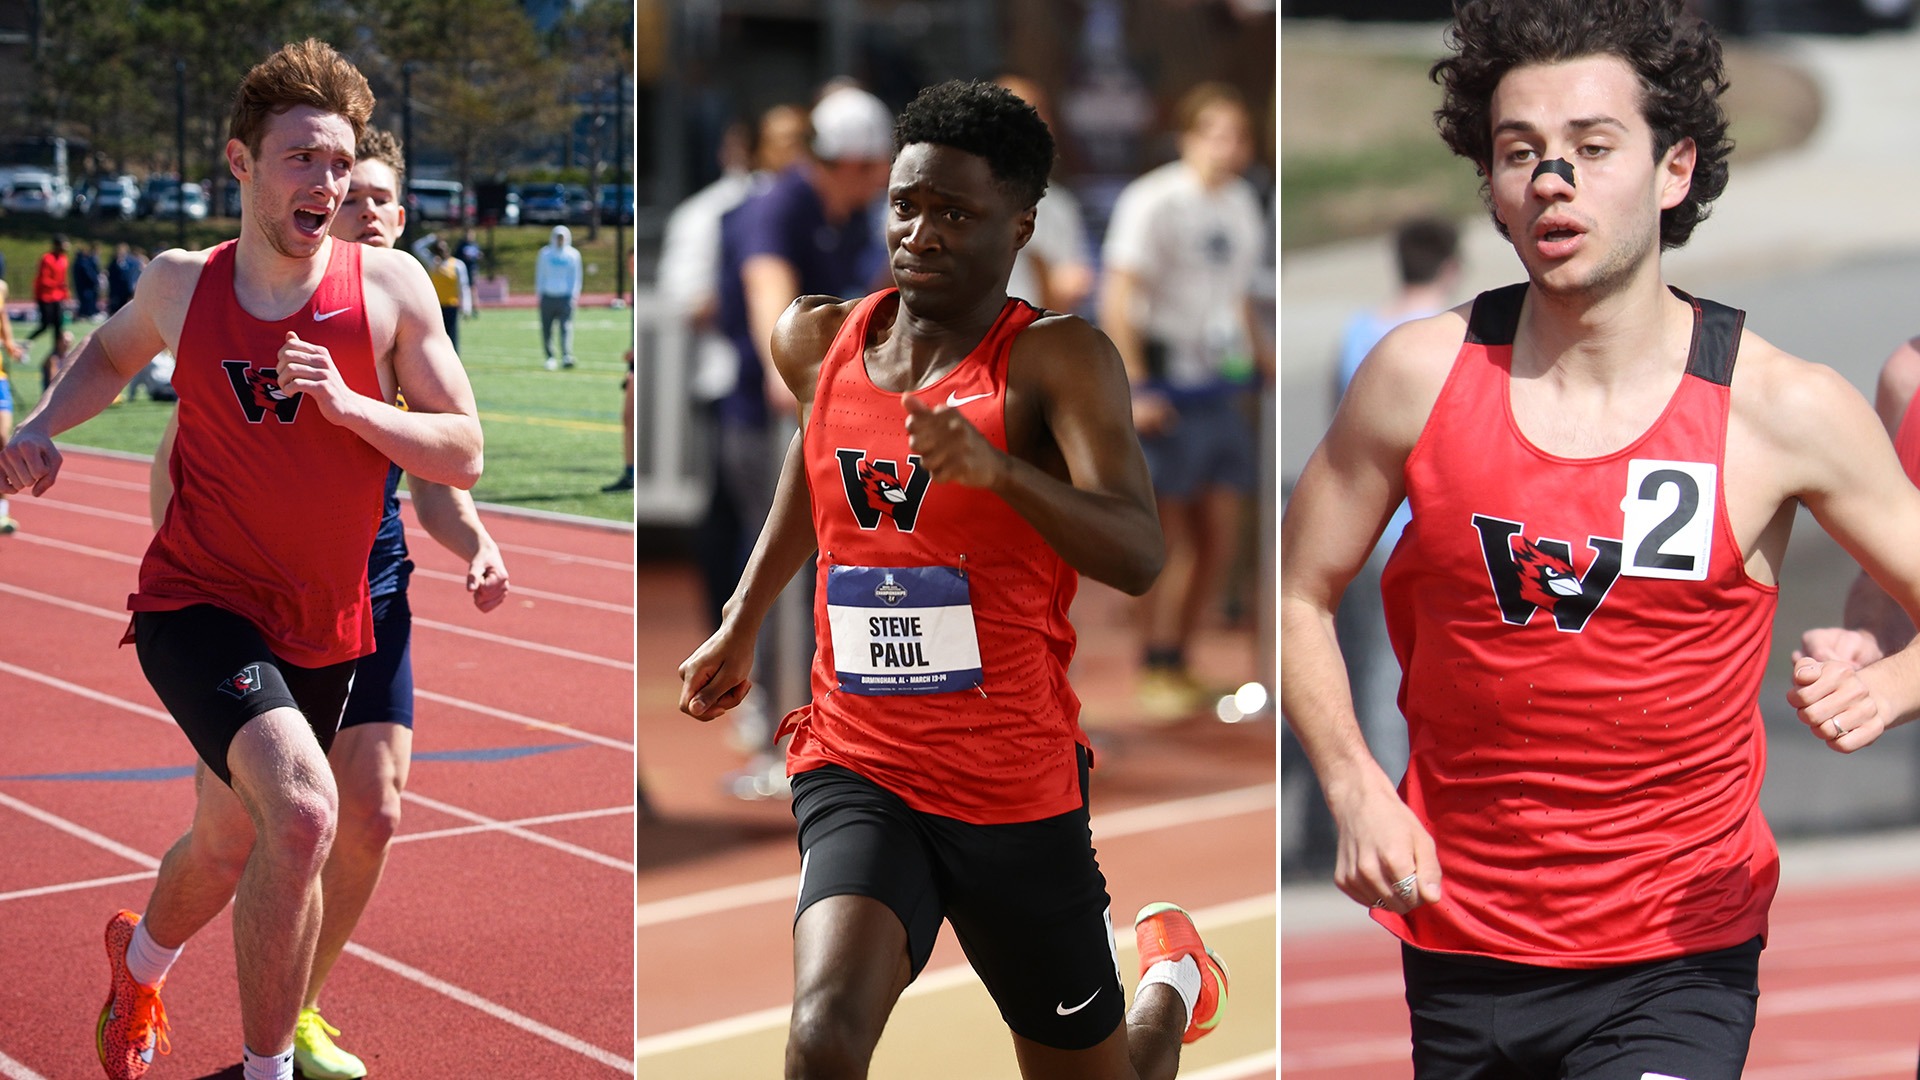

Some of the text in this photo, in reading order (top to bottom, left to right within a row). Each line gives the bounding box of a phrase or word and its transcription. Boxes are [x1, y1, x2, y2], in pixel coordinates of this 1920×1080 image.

[835, 448, 932, 533] W
[1633, 469, 1699, 571] 2
[1471, 513, 1623, 633] W
[869, 616, 922, 637] STEVE
[861, 674, 947, 684] BIRMINGHAM, AL MARCH 13-14
[870, 642, 930, 667] PAUL
